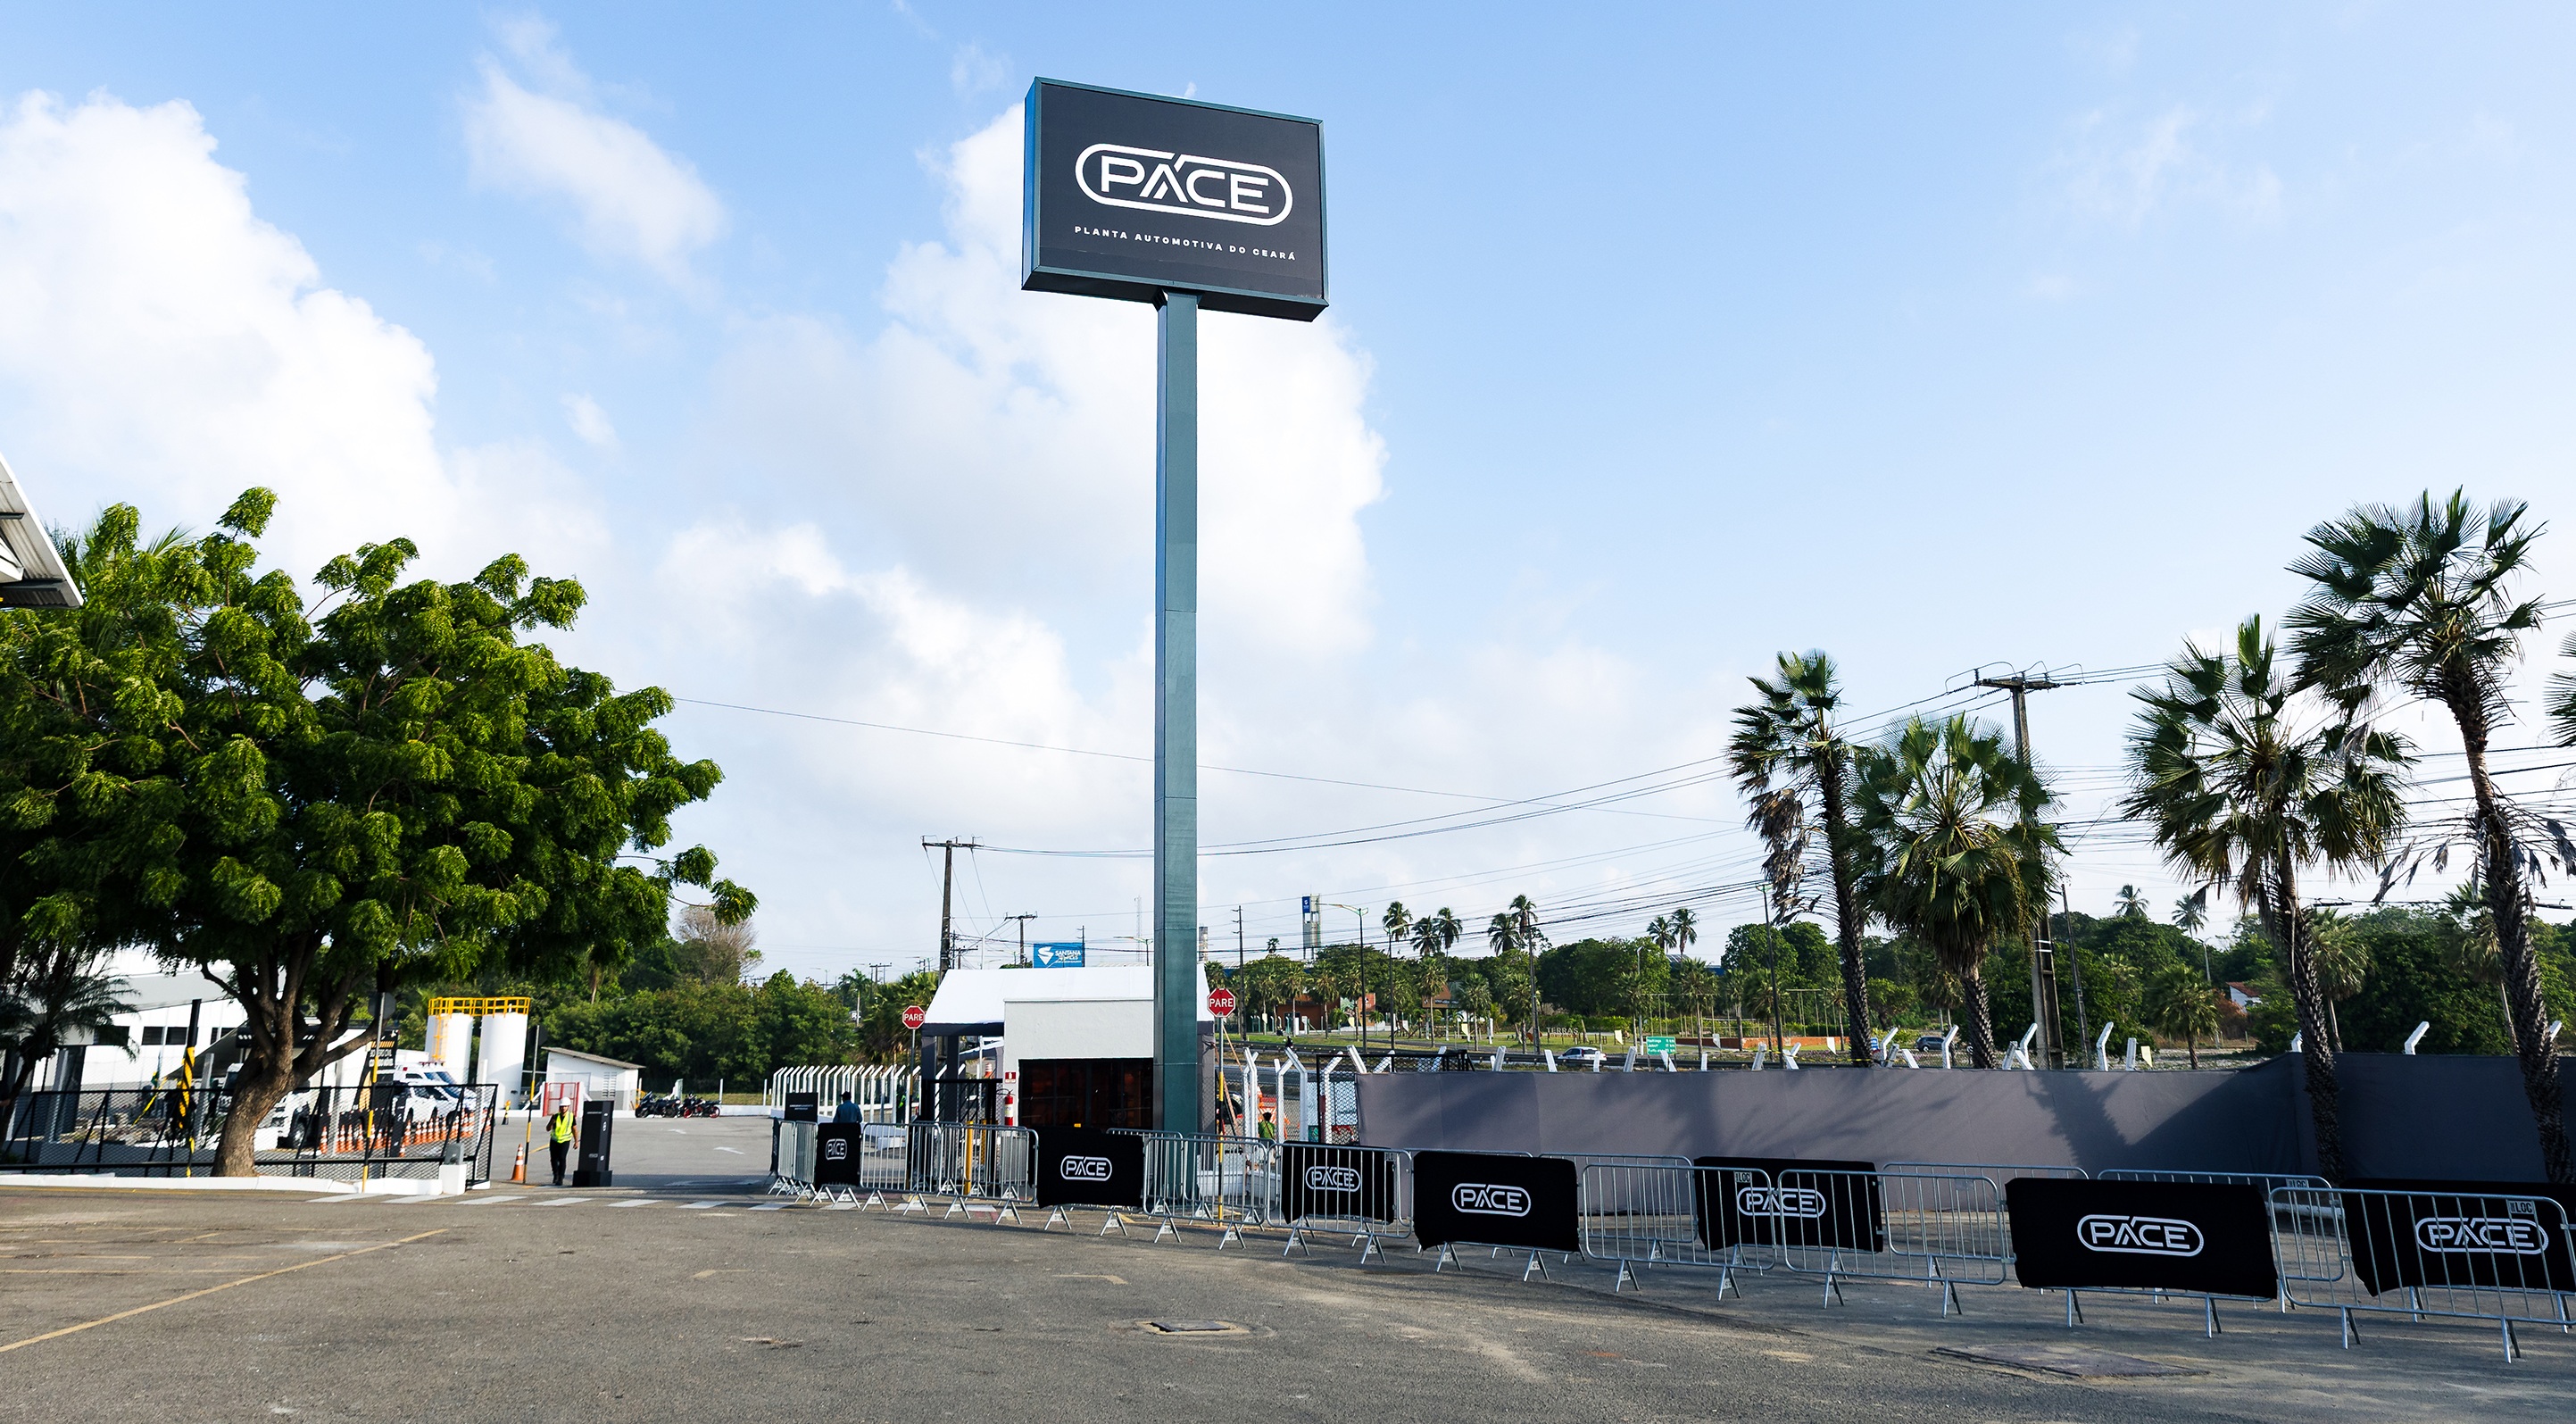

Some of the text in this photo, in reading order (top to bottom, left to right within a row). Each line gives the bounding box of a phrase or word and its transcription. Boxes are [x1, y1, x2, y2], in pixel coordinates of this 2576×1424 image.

[1101, 155, 1269, 214] PACE
[1074, 226, 1296, 261] PLANTA AUTOMOTIVA DO CEARÁ
[1209, 998, 1234, 1007] PARE
[903, 1013, 924, 1021] PARE
[827, 1143, 845, 1156] PACE
[1065, 1160, 1107, 1177] PACE
[1310, 1170, 1355, 1187] PACE
[1460, 1188, 1523, 1211] PACE
[1745, 1193, 1816, 1212] PACE
[2090, 1221, 2190, 1250] PACE
[2427, 1224, 2535, 1248] PACE
